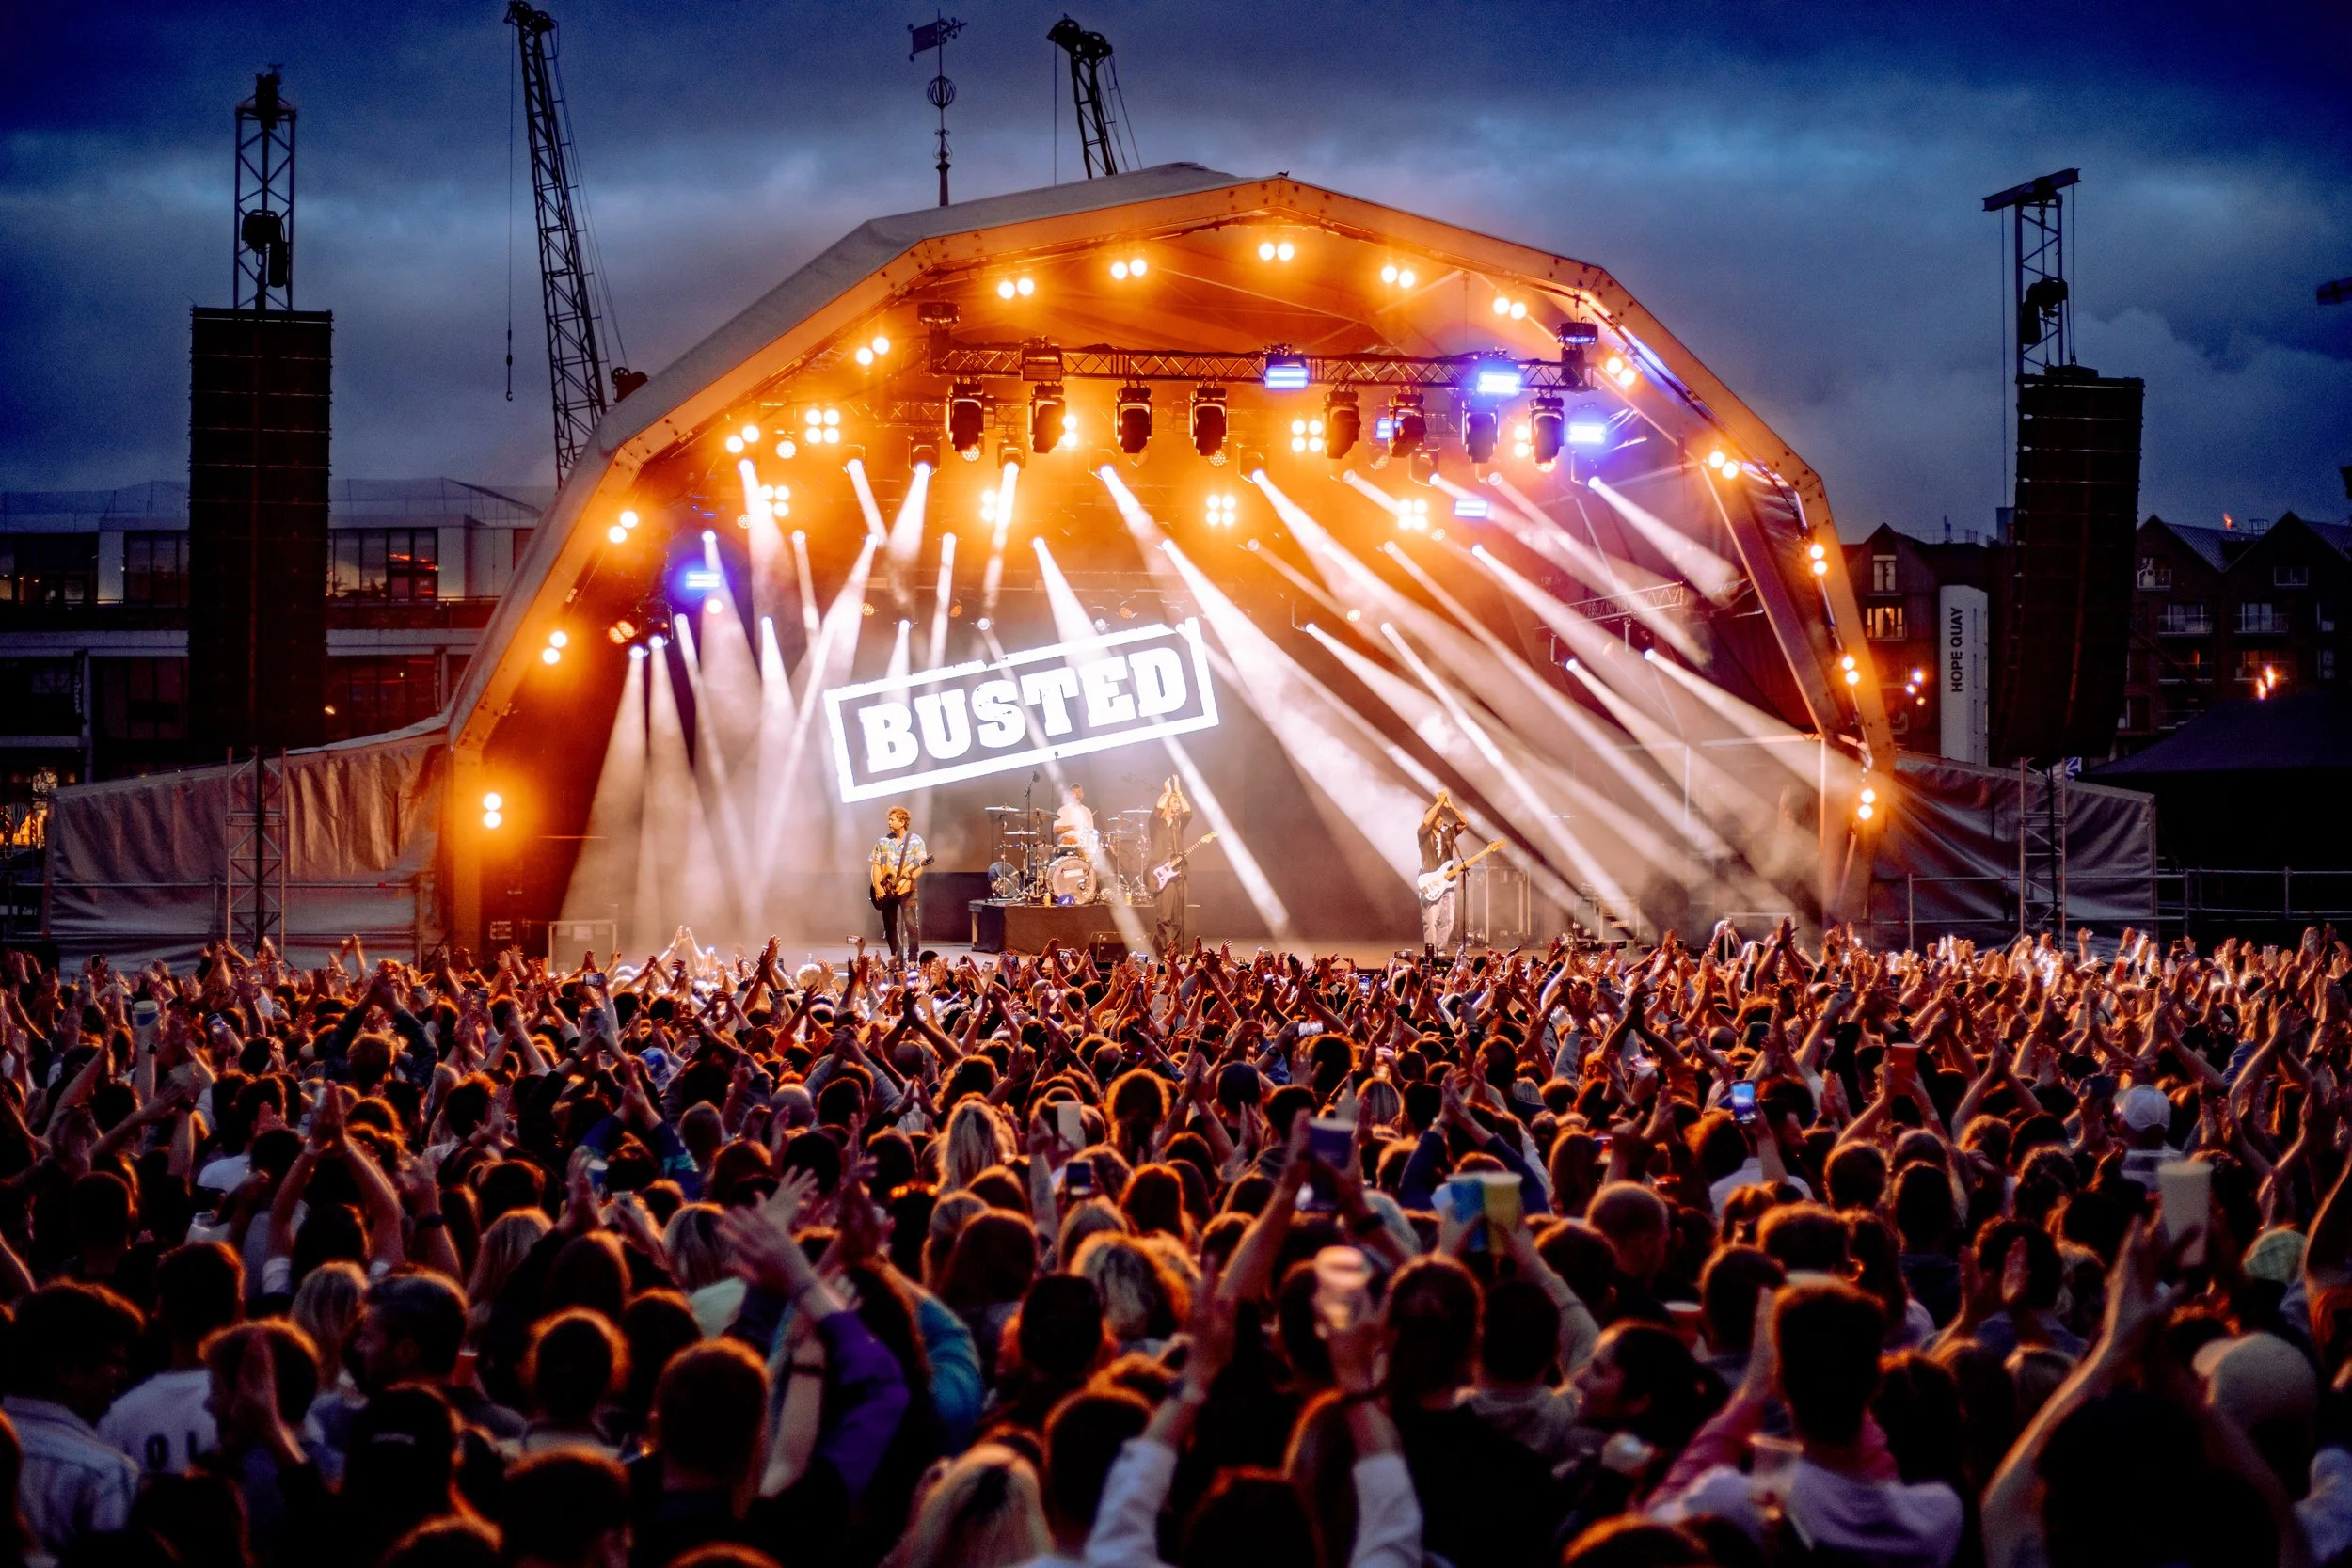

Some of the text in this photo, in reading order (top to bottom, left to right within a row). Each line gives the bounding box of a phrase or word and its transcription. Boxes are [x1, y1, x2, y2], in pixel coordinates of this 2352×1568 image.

[1950, 607, 1963, 692] HOPE QUAY
[857, 647, 1187, 773] BUSTED
